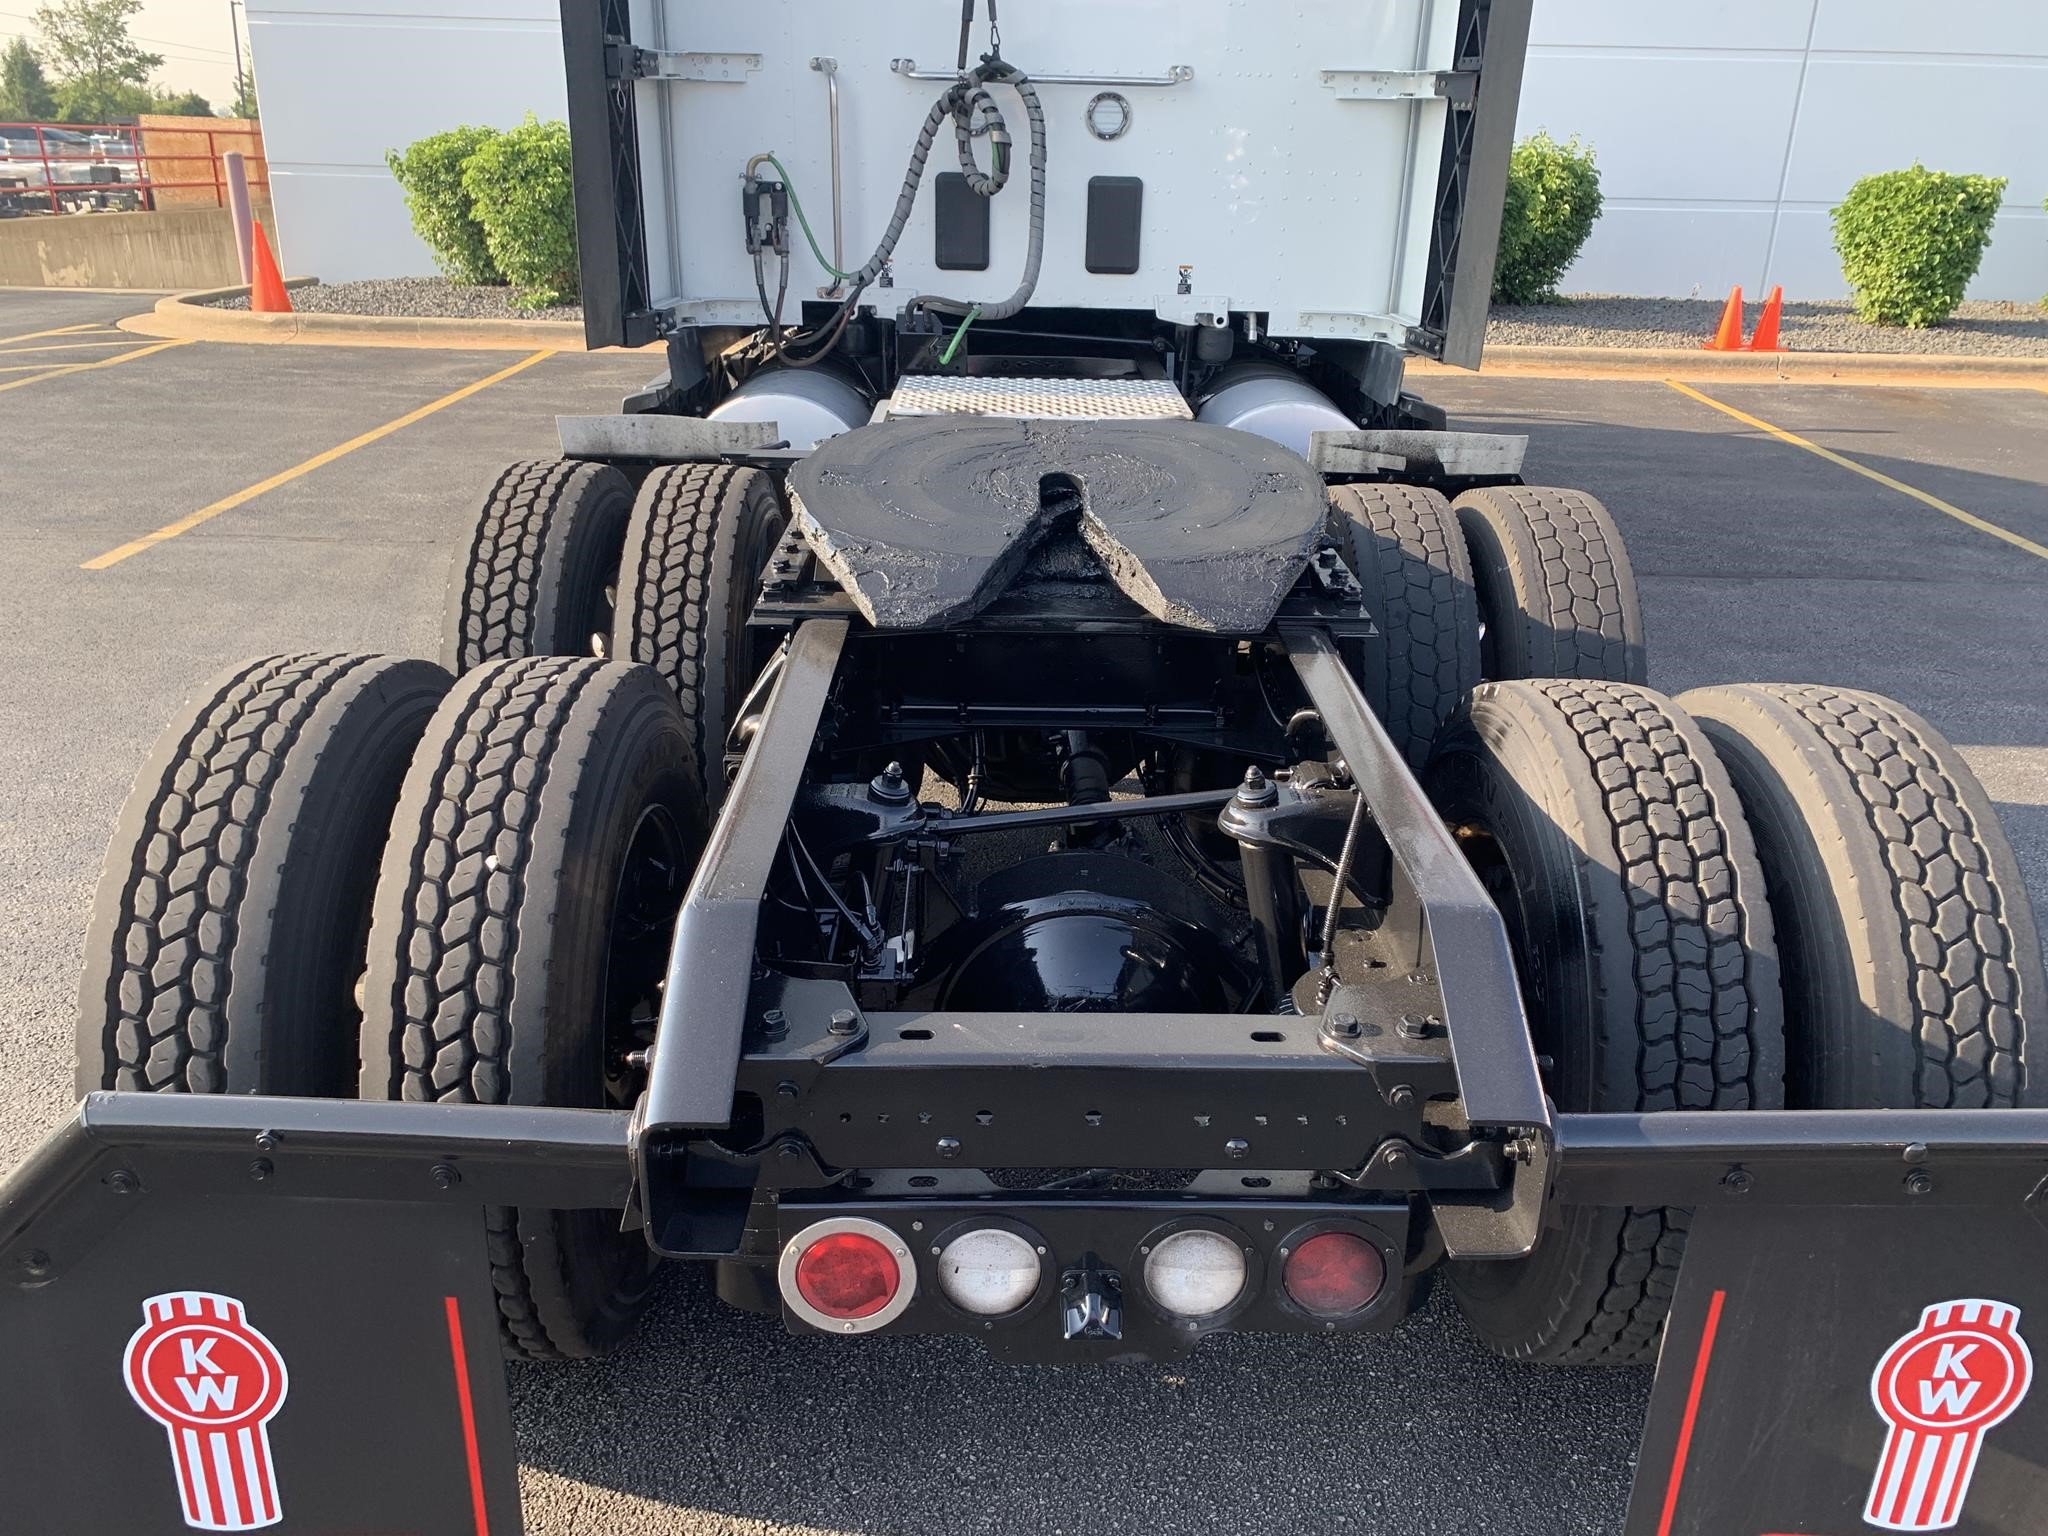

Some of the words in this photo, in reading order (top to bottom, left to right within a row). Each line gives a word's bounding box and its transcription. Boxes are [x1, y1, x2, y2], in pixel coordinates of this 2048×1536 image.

[180, 1338, 226, 1374] K
[1933, 1343, 1980, 1379] K
[173, 1375, 239, 1412] W
[1919, 1380, 1983, 1415] W
